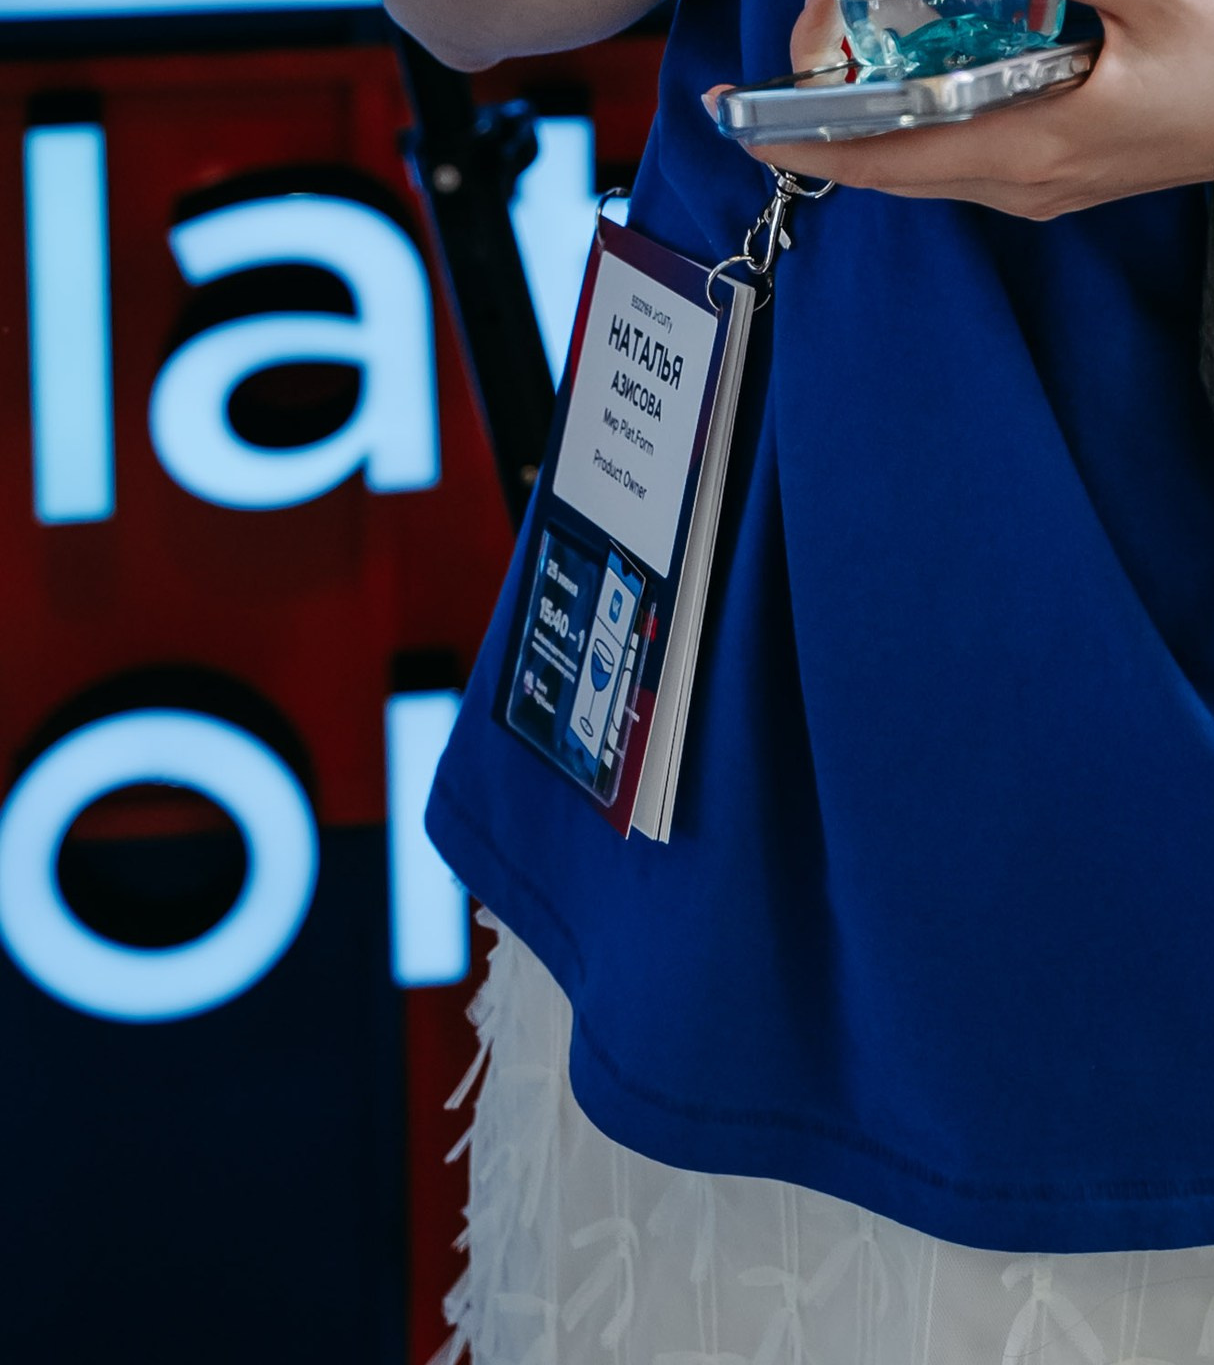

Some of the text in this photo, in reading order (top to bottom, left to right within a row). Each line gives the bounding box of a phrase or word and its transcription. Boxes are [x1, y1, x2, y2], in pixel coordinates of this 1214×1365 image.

[608, 314, 684, 391] НАТАЛЬЯ
[610, 370, 663, 422] АЗИСОВА
[602, 407, 655, 456] Мир Plat.Form
[592, 449, 648, 500] Product Owner
